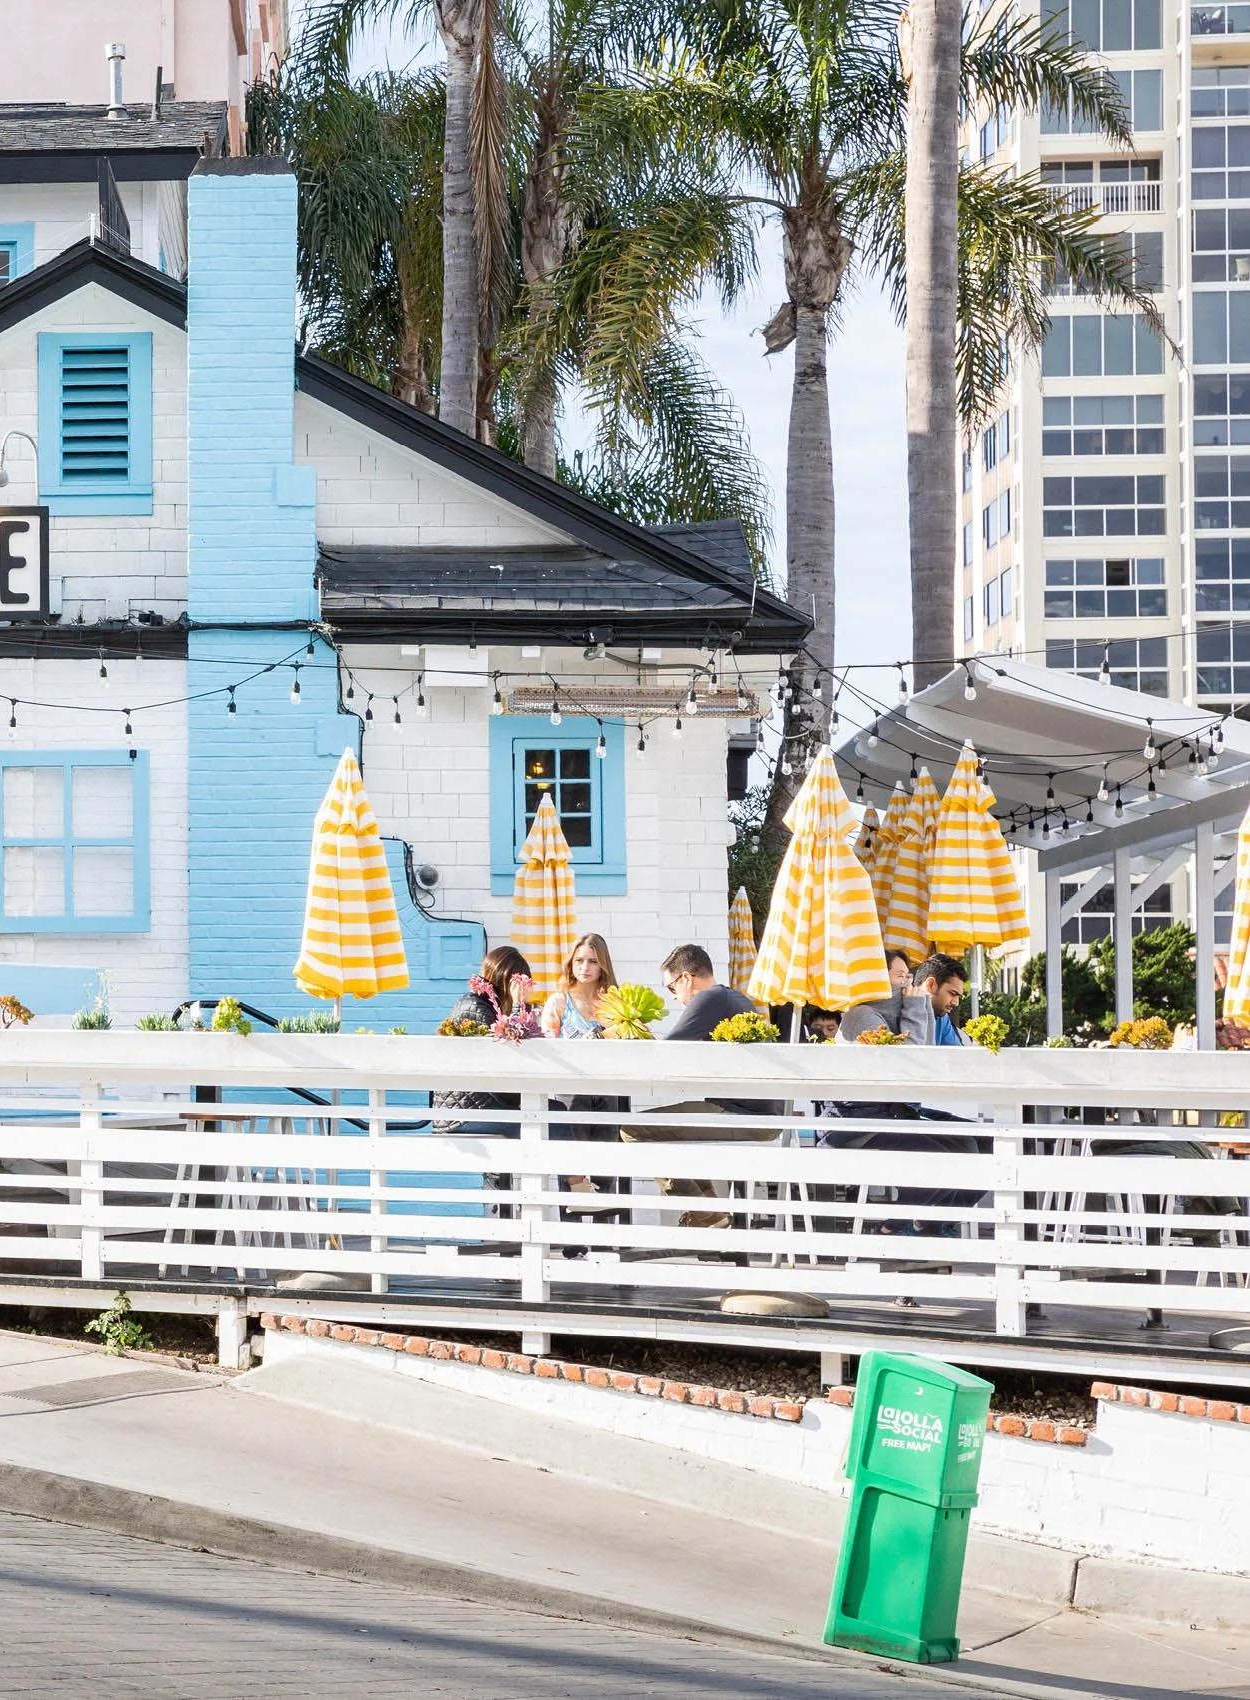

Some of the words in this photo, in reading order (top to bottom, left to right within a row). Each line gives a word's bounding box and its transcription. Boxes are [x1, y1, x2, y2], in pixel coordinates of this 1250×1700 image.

[893, 1423, 942, 1444] SOCIAL
[881, 1437, 906, 1449] FREE
[906, 1440, 932, 1453] MAP!
